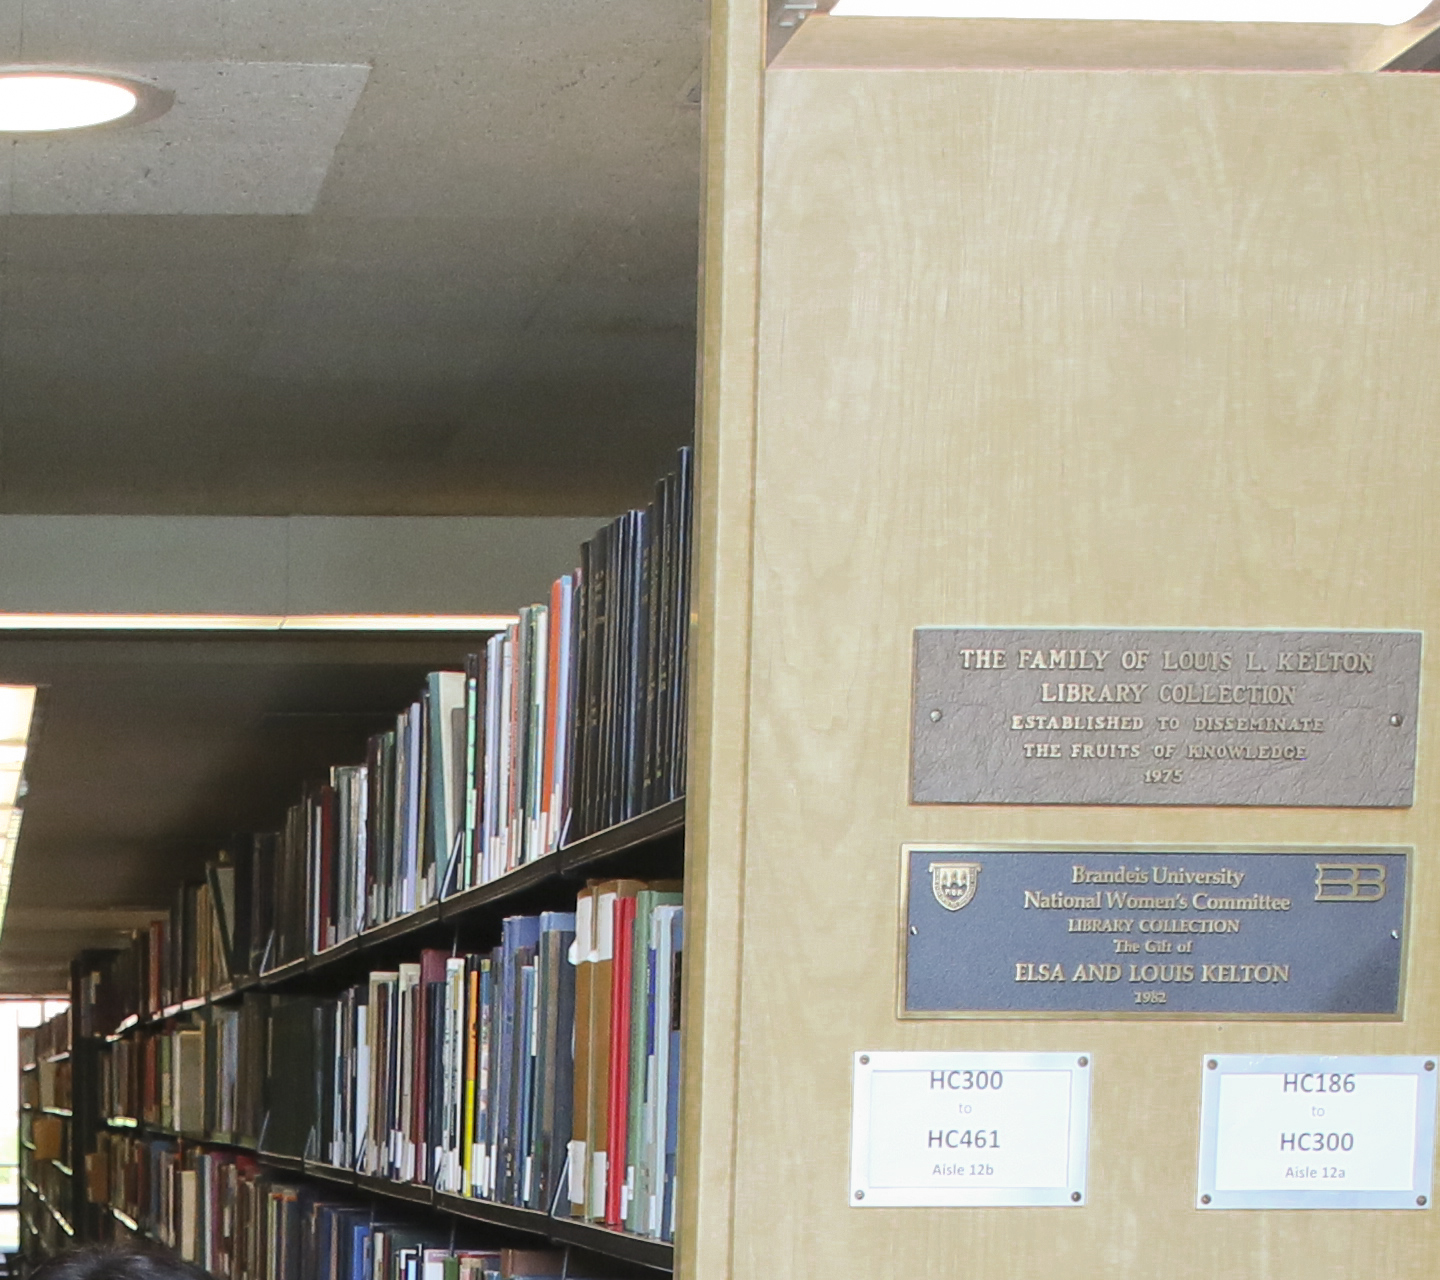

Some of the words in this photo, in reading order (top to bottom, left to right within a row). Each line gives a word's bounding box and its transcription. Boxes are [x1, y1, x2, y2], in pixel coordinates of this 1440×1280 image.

[959, 649, 1007, 671] THE
[1019, 649, 1112, 671] FAMILY
[1122, 650, 1149, 671] OF
[1162, 651, 1232, 672] LOUIS
[1246, 652, 1268, 672] L.
[1276, 651, 1374, 673] KELTON
[1041, 683, 1149, 704] LIBRARY
[1159, 684, 1296, 705] COLLECTION
[1010, 715, 1144, 732] ESTABLISHED
[1158, 716, 1180, 731] TO
[1193, 716, 1325, 733] DISSEMINATE
[1023, 742, 1061, 758] THE
[1071, 742, 1141, 758] FRUITS
[1154, 743, 1176, 759] OF
[1187, 743, 1307, 760] KNOWLEDGE
[1144, 769, 1183, 784] 1975
[1072, 865, 1149, 885] Brandeis
[1153, 866, 1246, 889] University
[1023, 890, 1102, 910] National
[1106, 890, 1188, 910] Women's
[1192, 892, 1291, 911] Committee
[1068, 918, 1134, 933] LIBRARY
[1139, 918, 1240, 933] COLLECTION
[1113, 939, 1140, 954] The
[1144, 939, 1173, 955] Gift
[1177, 940, 1193, 954] of
[1015, 964, 1066, 983] ELSA
[1072, 964, 1121, 983] AND
[1129, 964, 1195, 984] LOUIS
[1201, 964, 1290, 985] KELTON
[1134, 991, 1167, 1005] 1982
[930, 1070, 1003, 1090] HC300
[1283, 1073, 1356, 1093] HC186
[958, 1104, 972, 1114] to
[1311, 1106, 1325, 1117] to
[928, 1129, 1000, 1149] HC461
[1280, 1132, 1354, 1151] HC300
[932, 1164, 965, 1176] Aisle
[969, 1163, 994, 1176] 12b
[1285, 1166, 1318, 1179] Aisle
[1322, 1166, 1346, 1179] 12a
